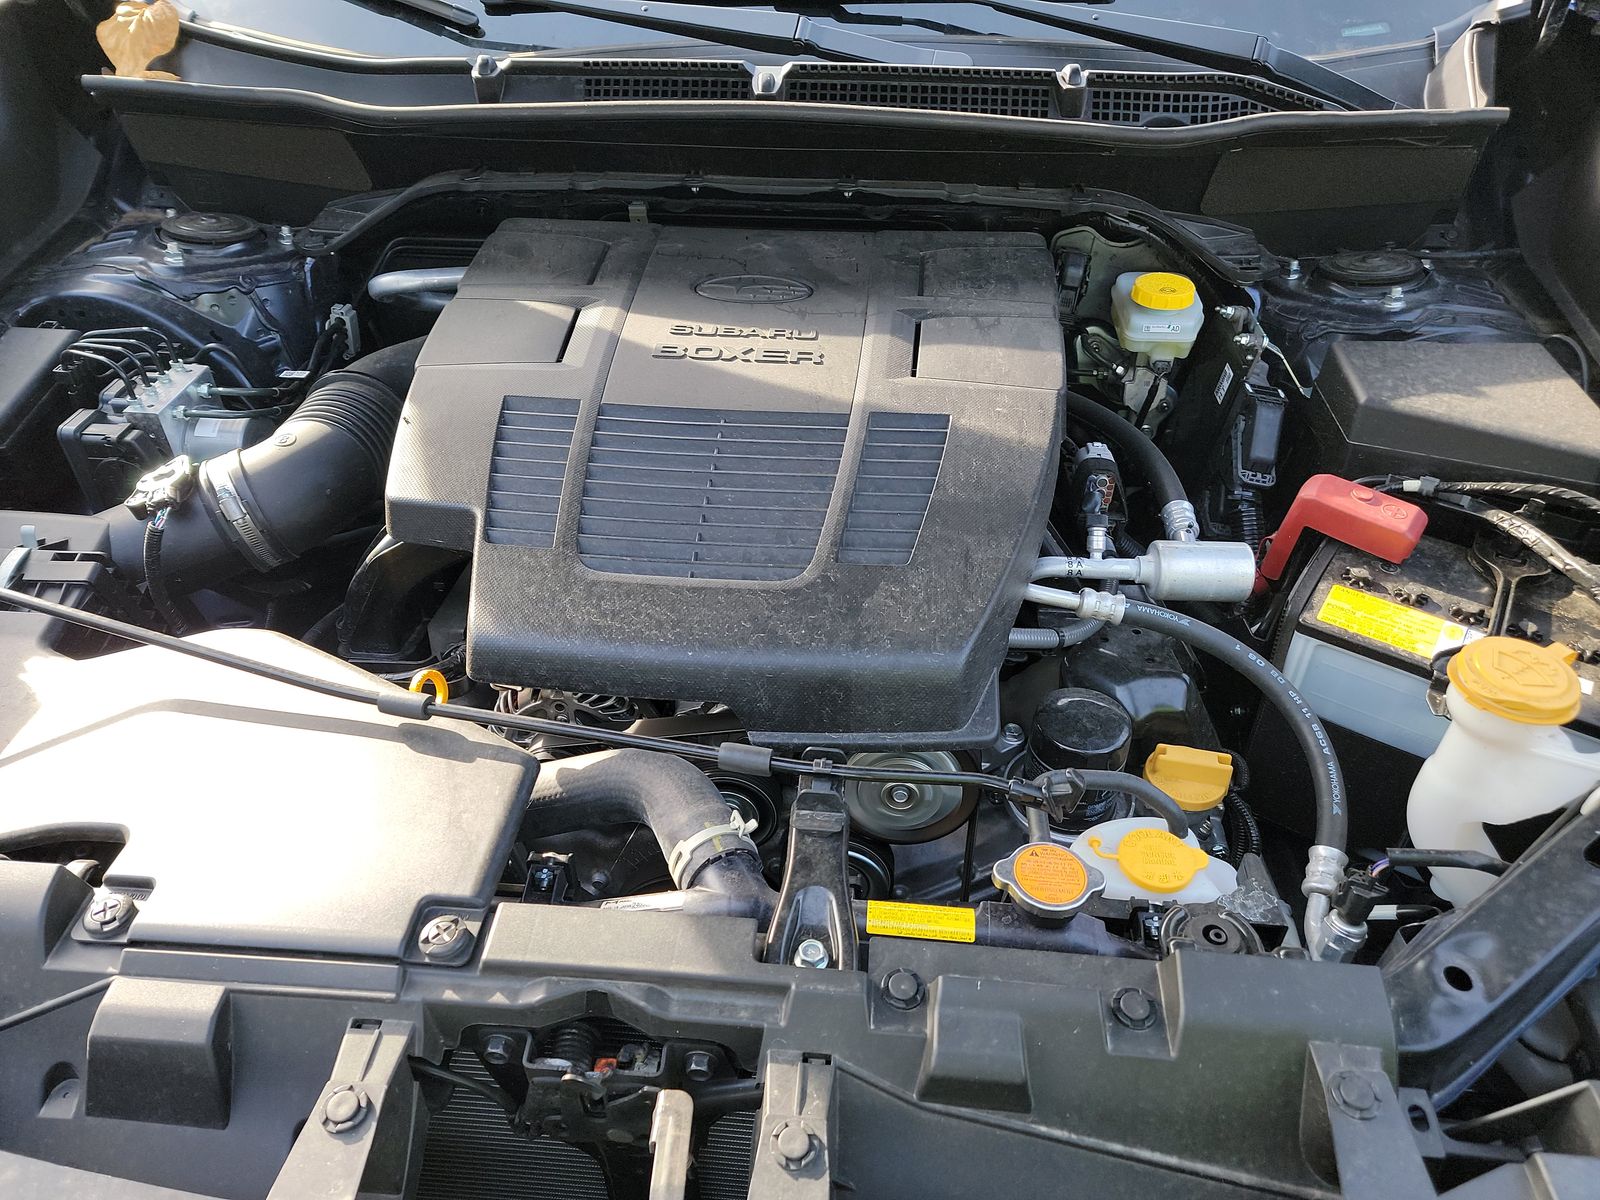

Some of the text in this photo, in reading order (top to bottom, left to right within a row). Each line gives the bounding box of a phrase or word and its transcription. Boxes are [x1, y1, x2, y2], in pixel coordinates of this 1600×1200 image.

[669, 324, 819, 340] SUBARU
[652, 343, 825, 365] BOXER
[1137, 605, 1178, 622] YOKOHAMA
[1288, 690, 1303, 705] HP
[1327, 761, 1341, 804] YOKOHAMA
